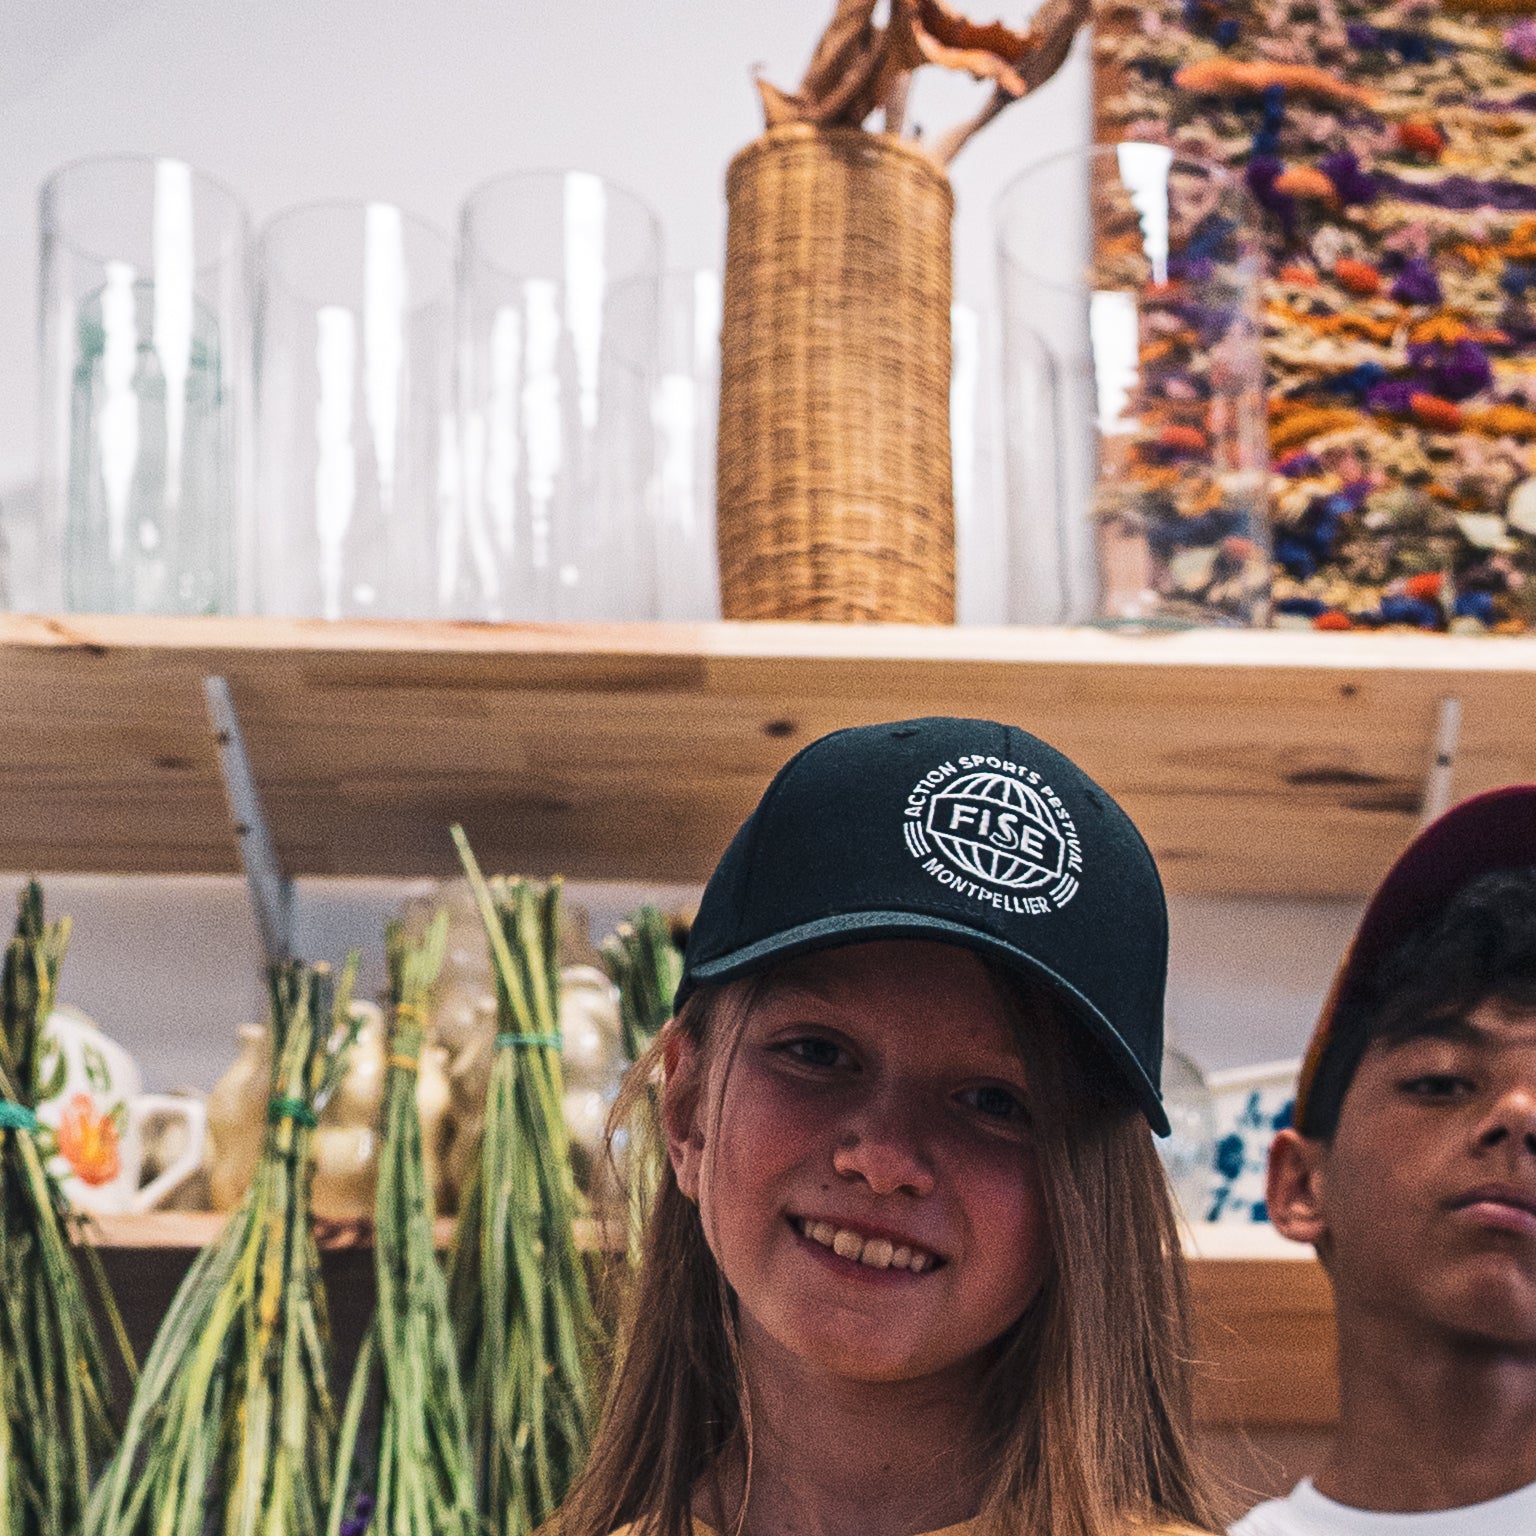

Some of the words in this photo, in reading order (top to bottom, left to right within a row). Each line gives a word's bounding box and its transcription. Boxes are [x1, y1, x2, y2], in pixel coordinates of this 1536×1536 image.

[904, 761, 957, 817] ACTION
[958, 754, 1041, 785] SPORTS
[949, 803, 1046, 860] FISE
[921, 857, 1052, 914] MONTPELLIER
